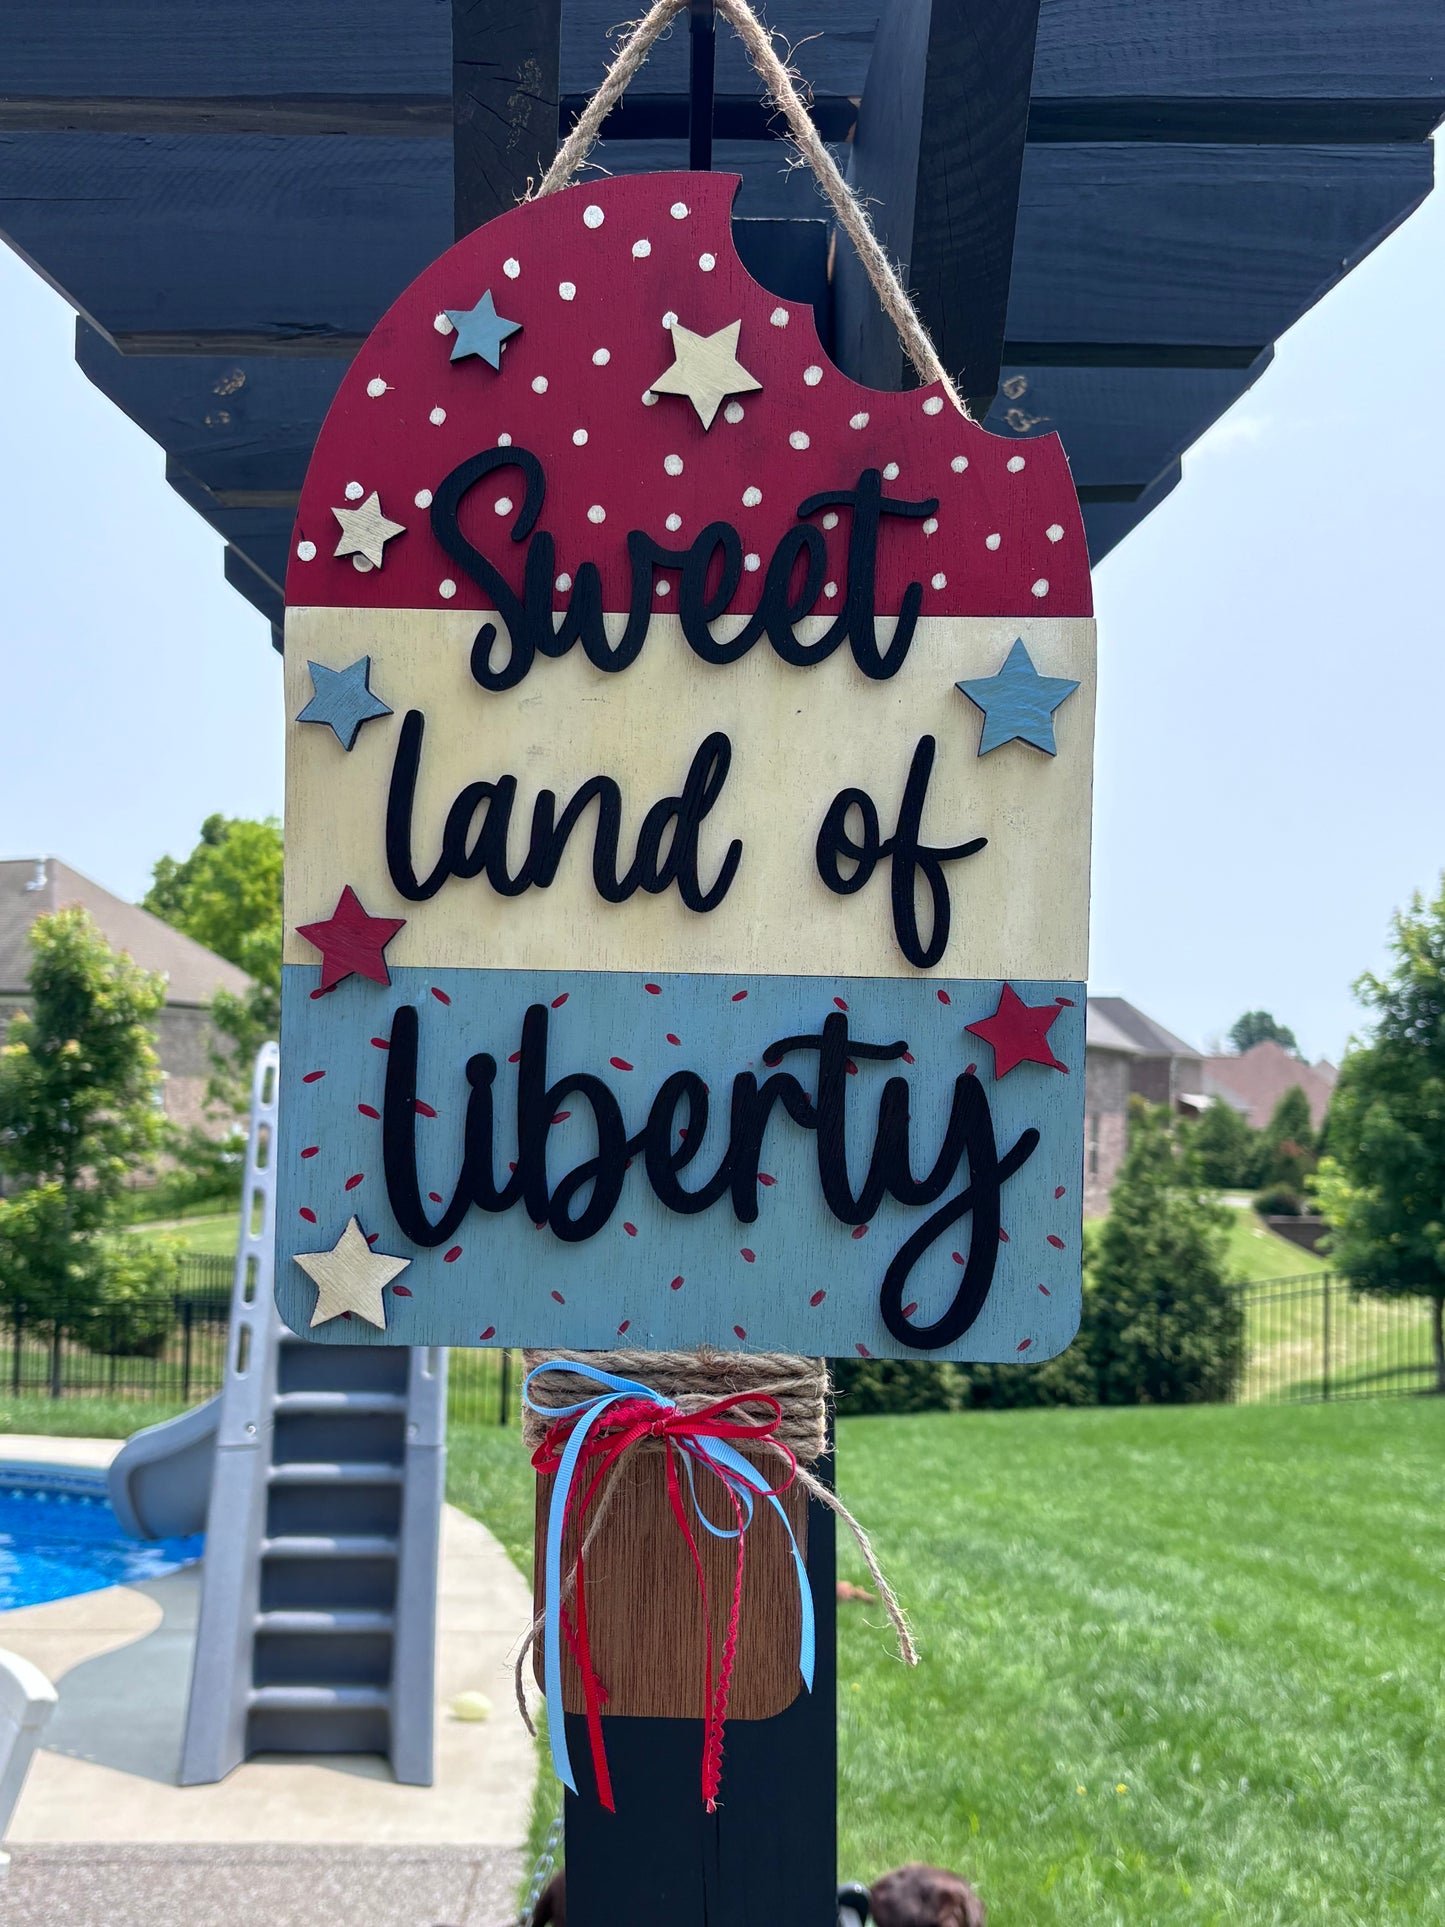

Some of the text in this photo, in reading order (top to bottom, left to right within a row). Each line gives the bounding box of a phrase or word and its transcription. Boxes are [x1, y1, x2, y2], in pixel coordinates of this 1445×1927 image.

[430, 446, 939, 691] Sweet
[386, 709, 989, 969] land of
[382, 1004, 1041, 1353] liberty
